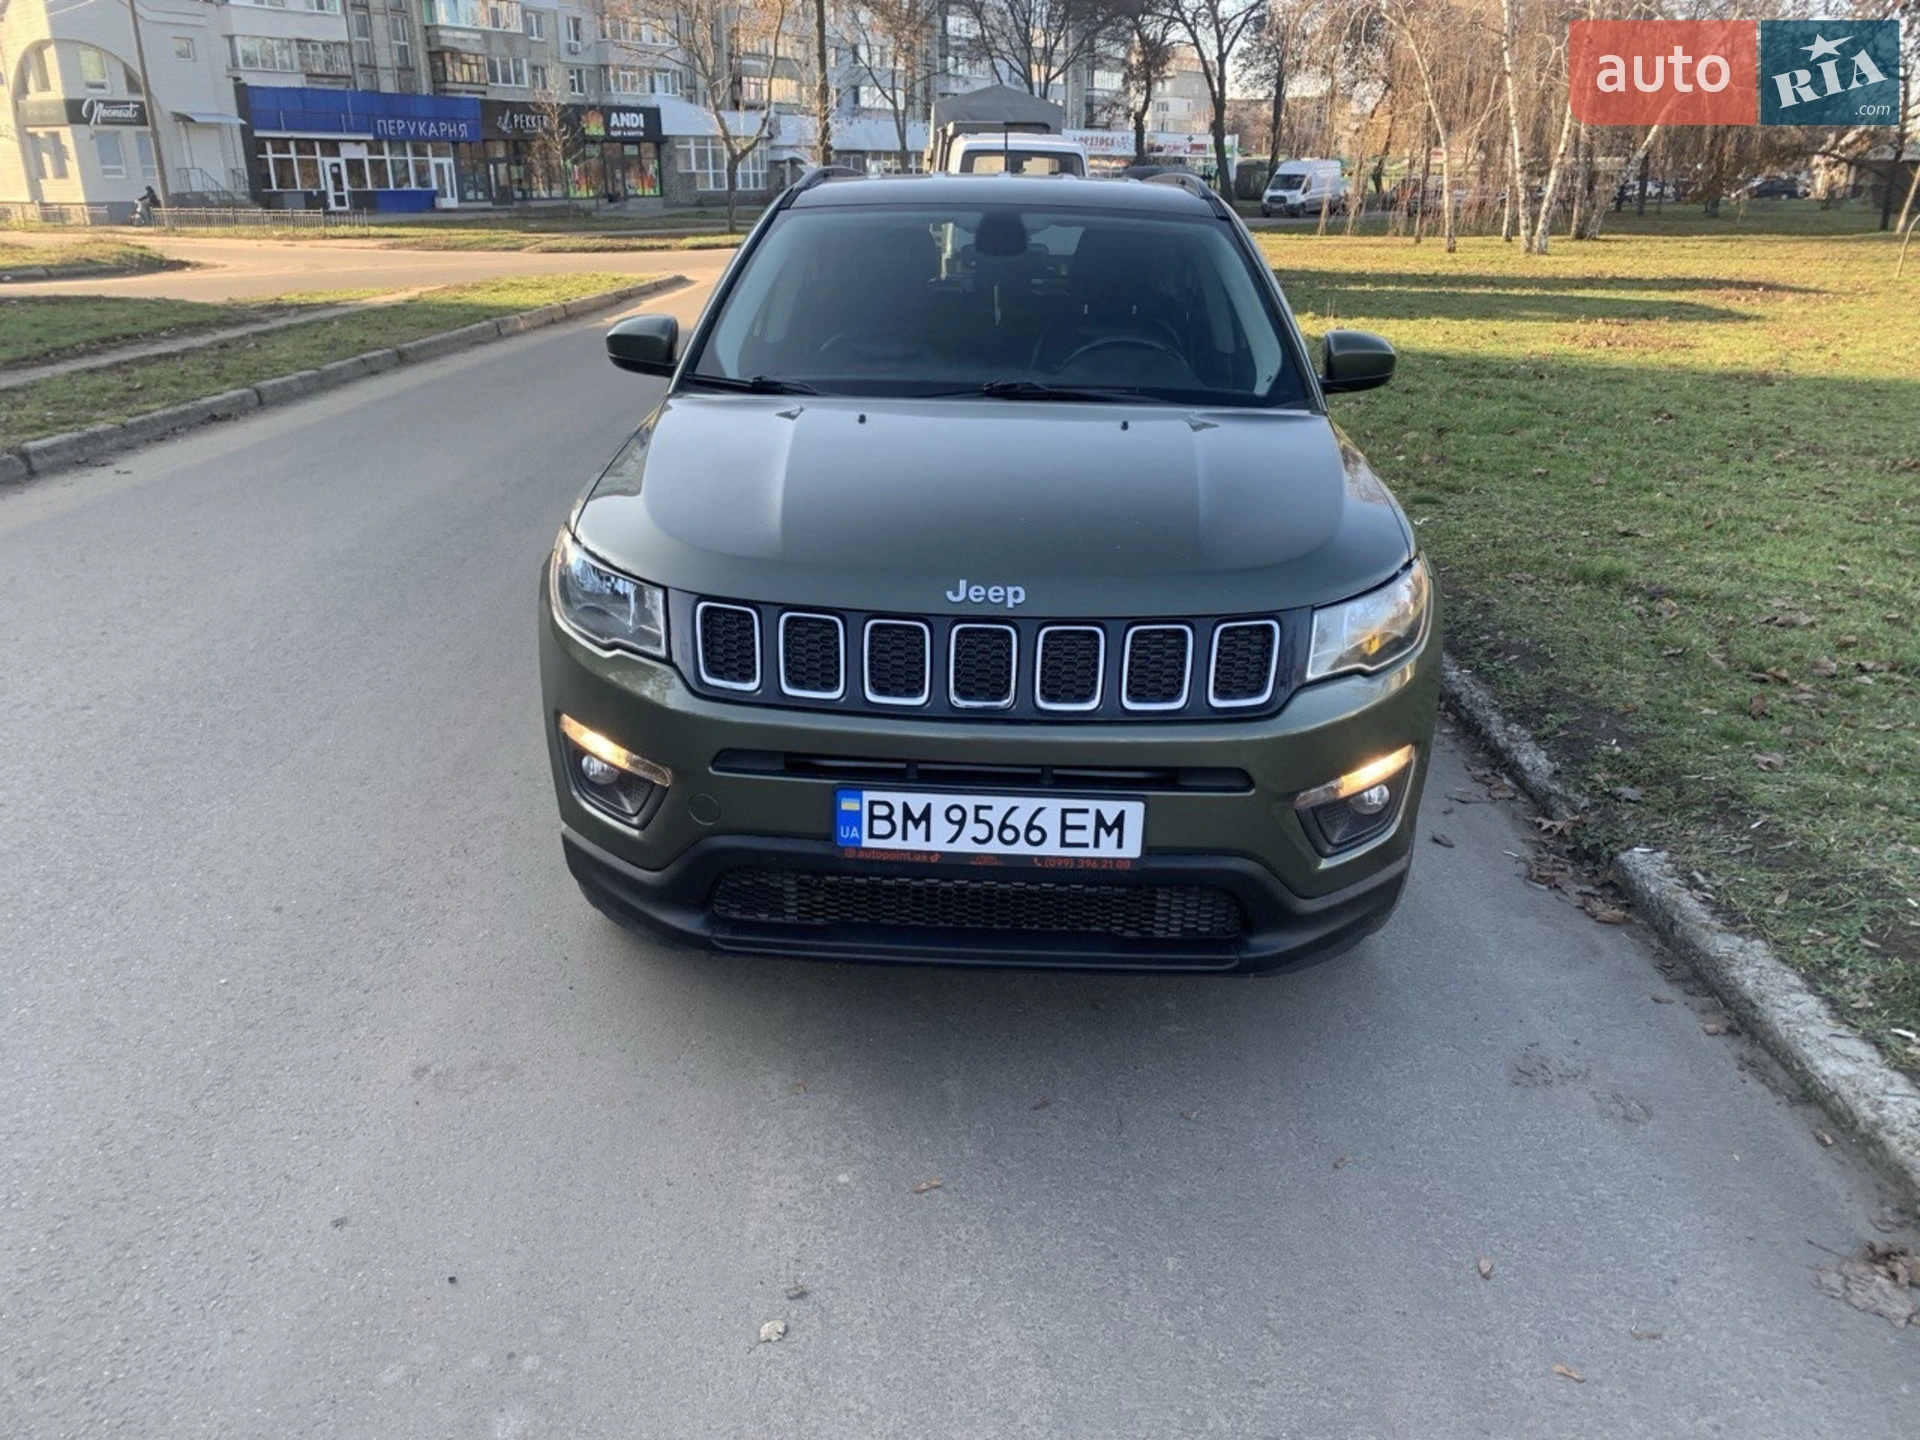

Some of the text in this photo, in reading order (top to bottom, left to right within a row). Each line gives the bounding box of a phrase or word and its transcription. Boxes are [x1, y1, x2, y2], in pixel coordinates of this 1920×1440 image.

[376, 119, 469, 138] ПЕРУКАРНЯ
[610, 112, 645, 128] ANDI
[945, 579, 1026, 608] Jeep
[840, 826, 860, 839] UA
[868, 800, 1126, 850] BM 9566 EM
